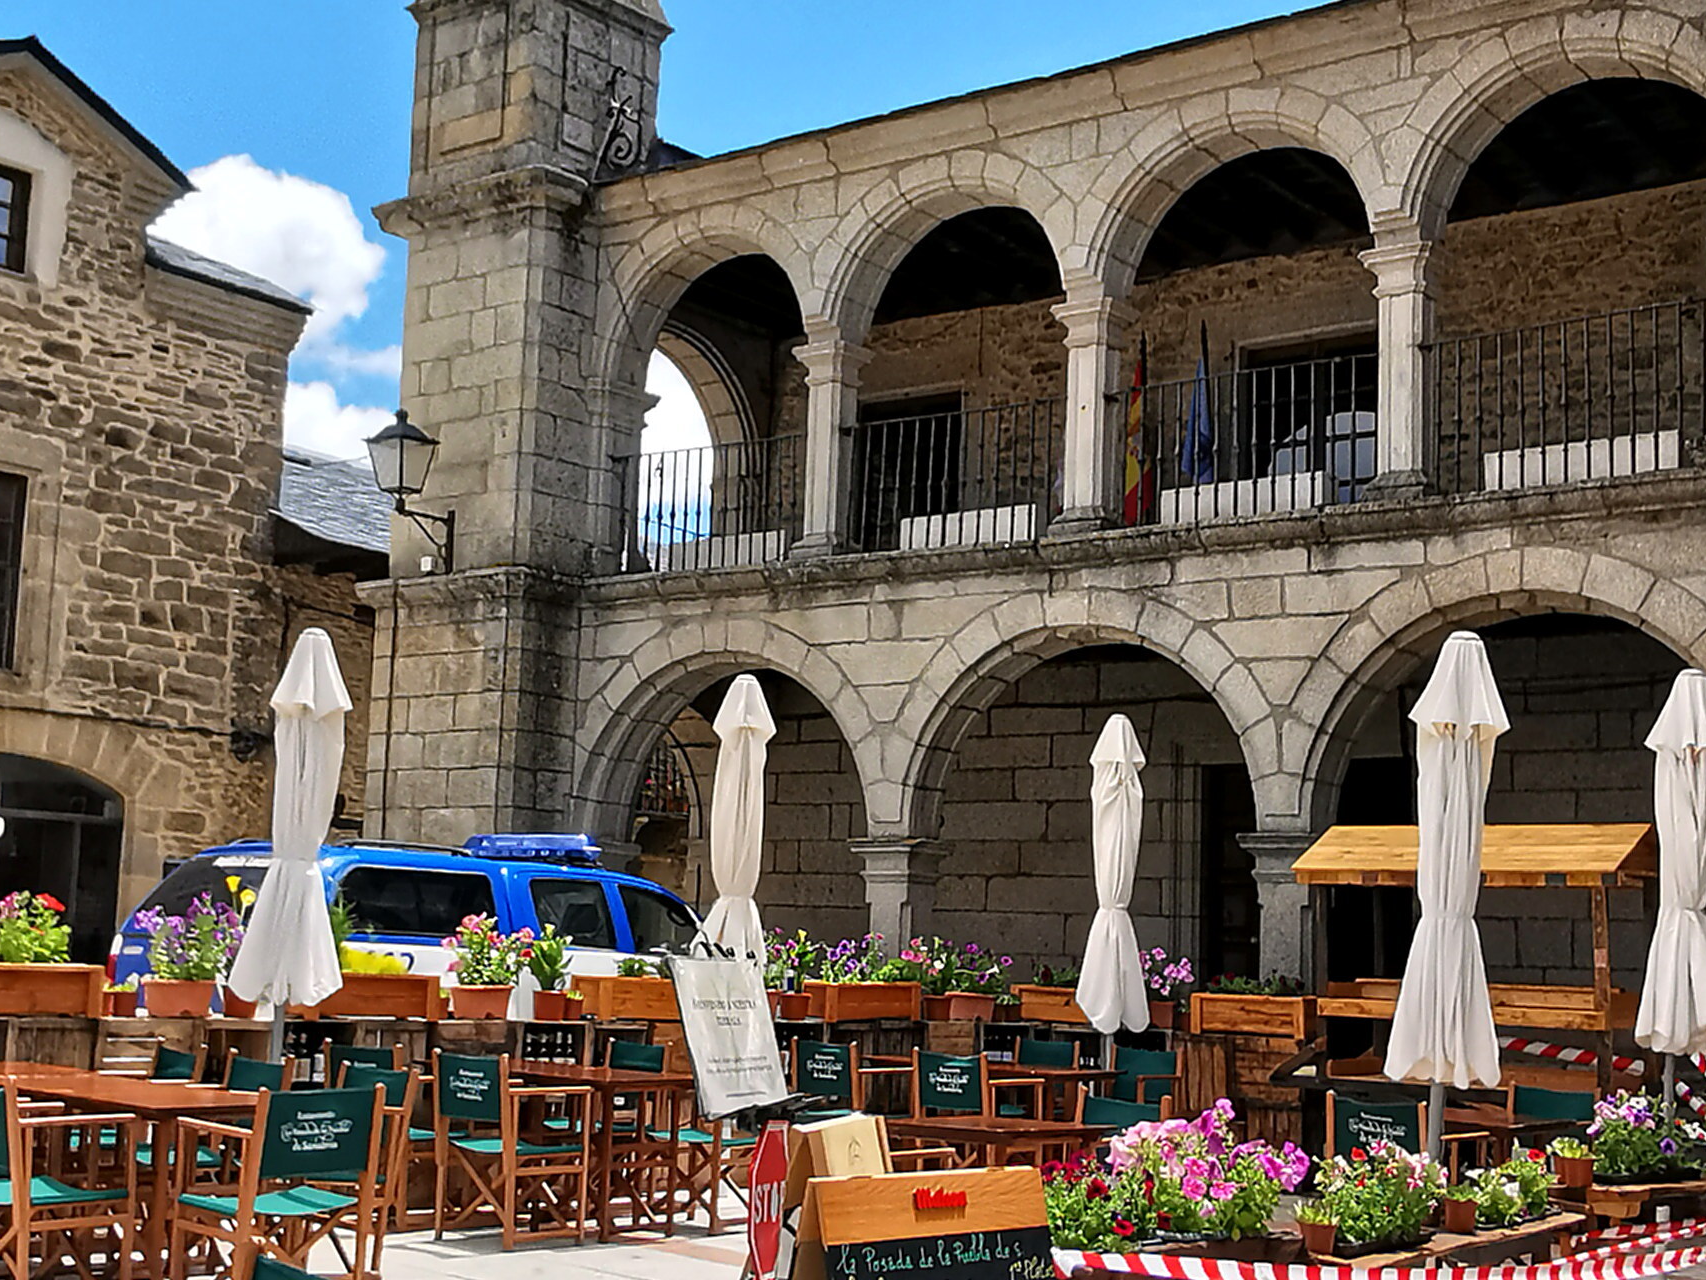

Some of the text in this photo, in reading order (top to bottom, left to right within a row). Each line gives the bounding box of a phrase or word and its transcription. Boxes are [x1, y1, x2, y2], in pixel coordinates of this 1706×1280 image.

[754, 1181, 787, 1223] STOP
[862, 1246, 914, 1270] Posada
[919, 1247, 934, 1269] de
[937, 1240, 951, 1266] la
[996, 1233, 1010, 1258] de
